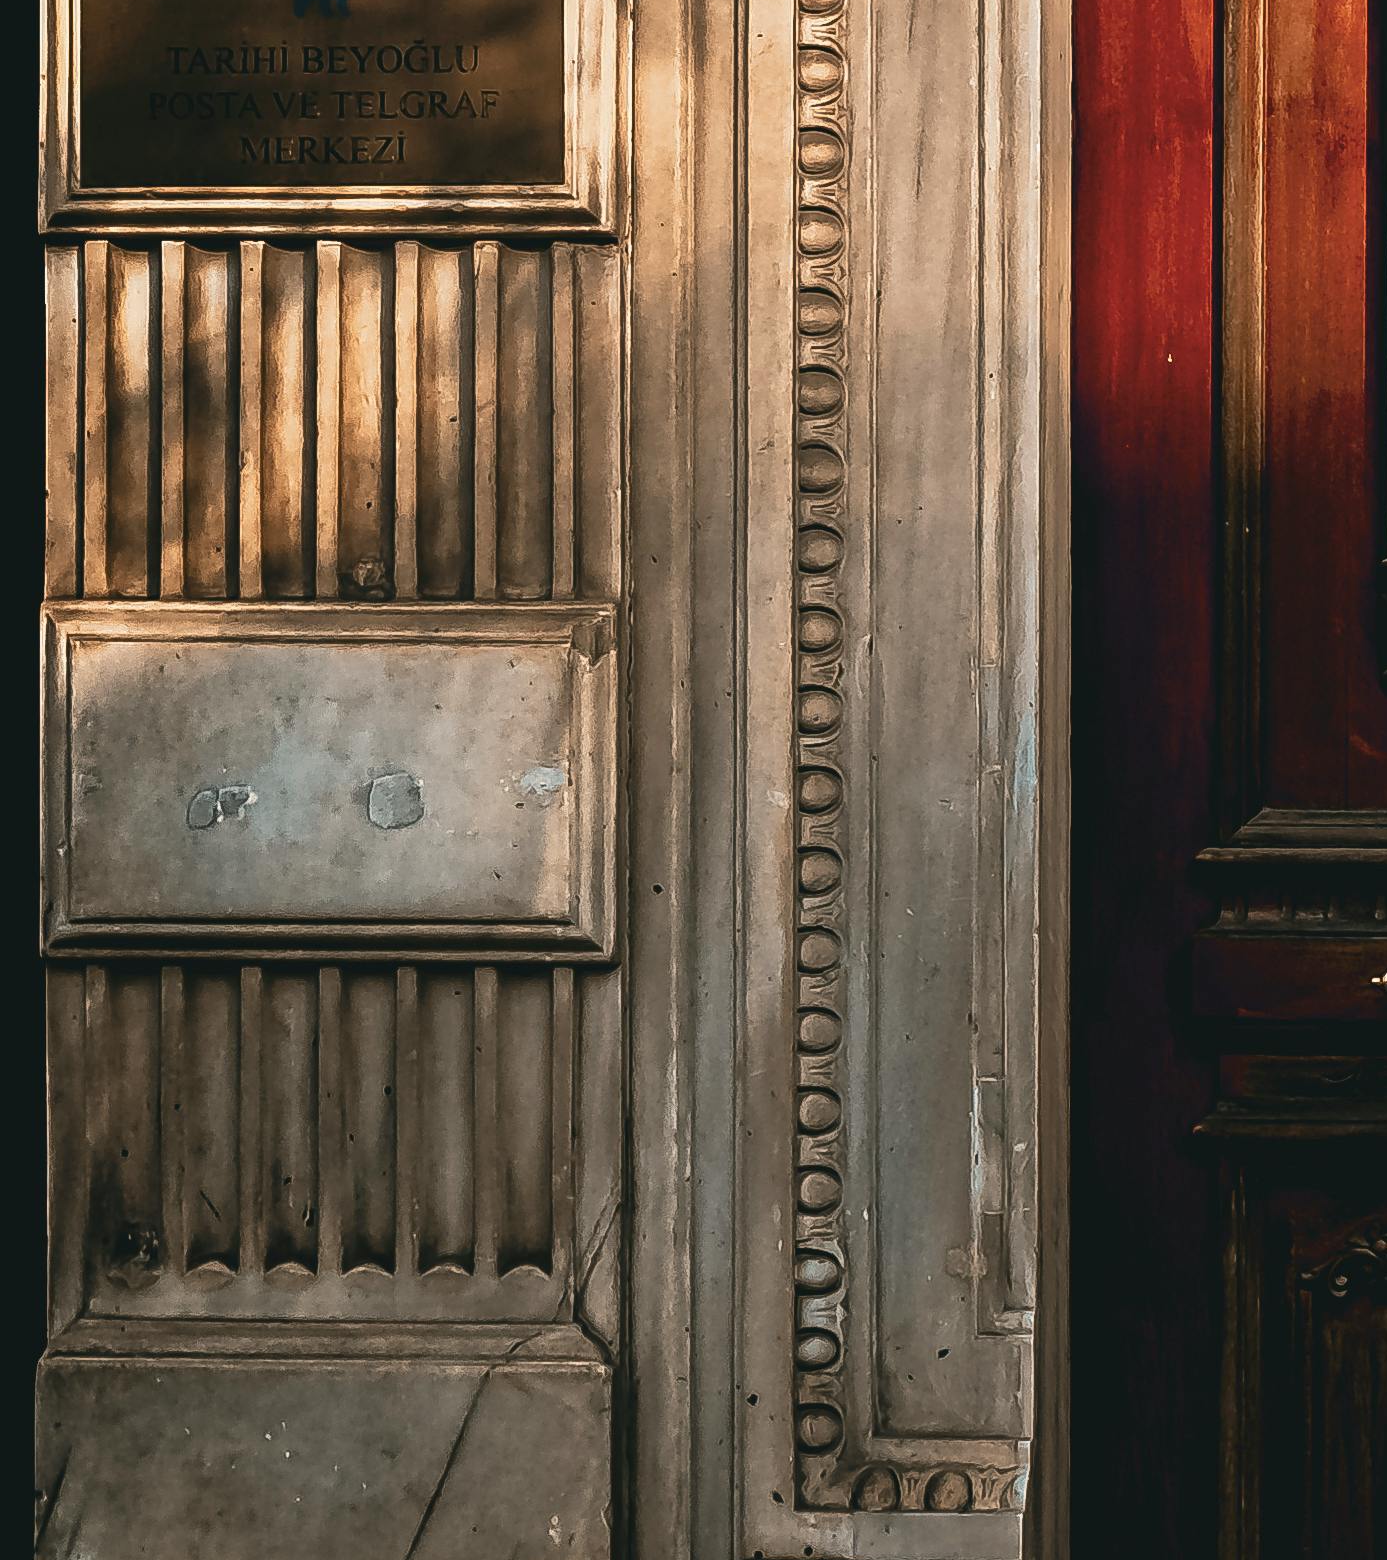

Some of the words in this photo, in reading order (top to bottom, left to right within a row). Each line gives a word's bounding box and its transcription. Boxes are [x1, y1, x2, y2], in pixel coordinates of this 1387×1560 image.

[166, 39, 289, 75] TARİHİ
[302, 38, 480, 75] BEYOĞLU
[148, 90, 262, 120] POSTA
[272, 91, 321, 119] VE
[331, 89, 501, 120] TELGRAF
[240, 130, 408, 165] MERKEZİ
